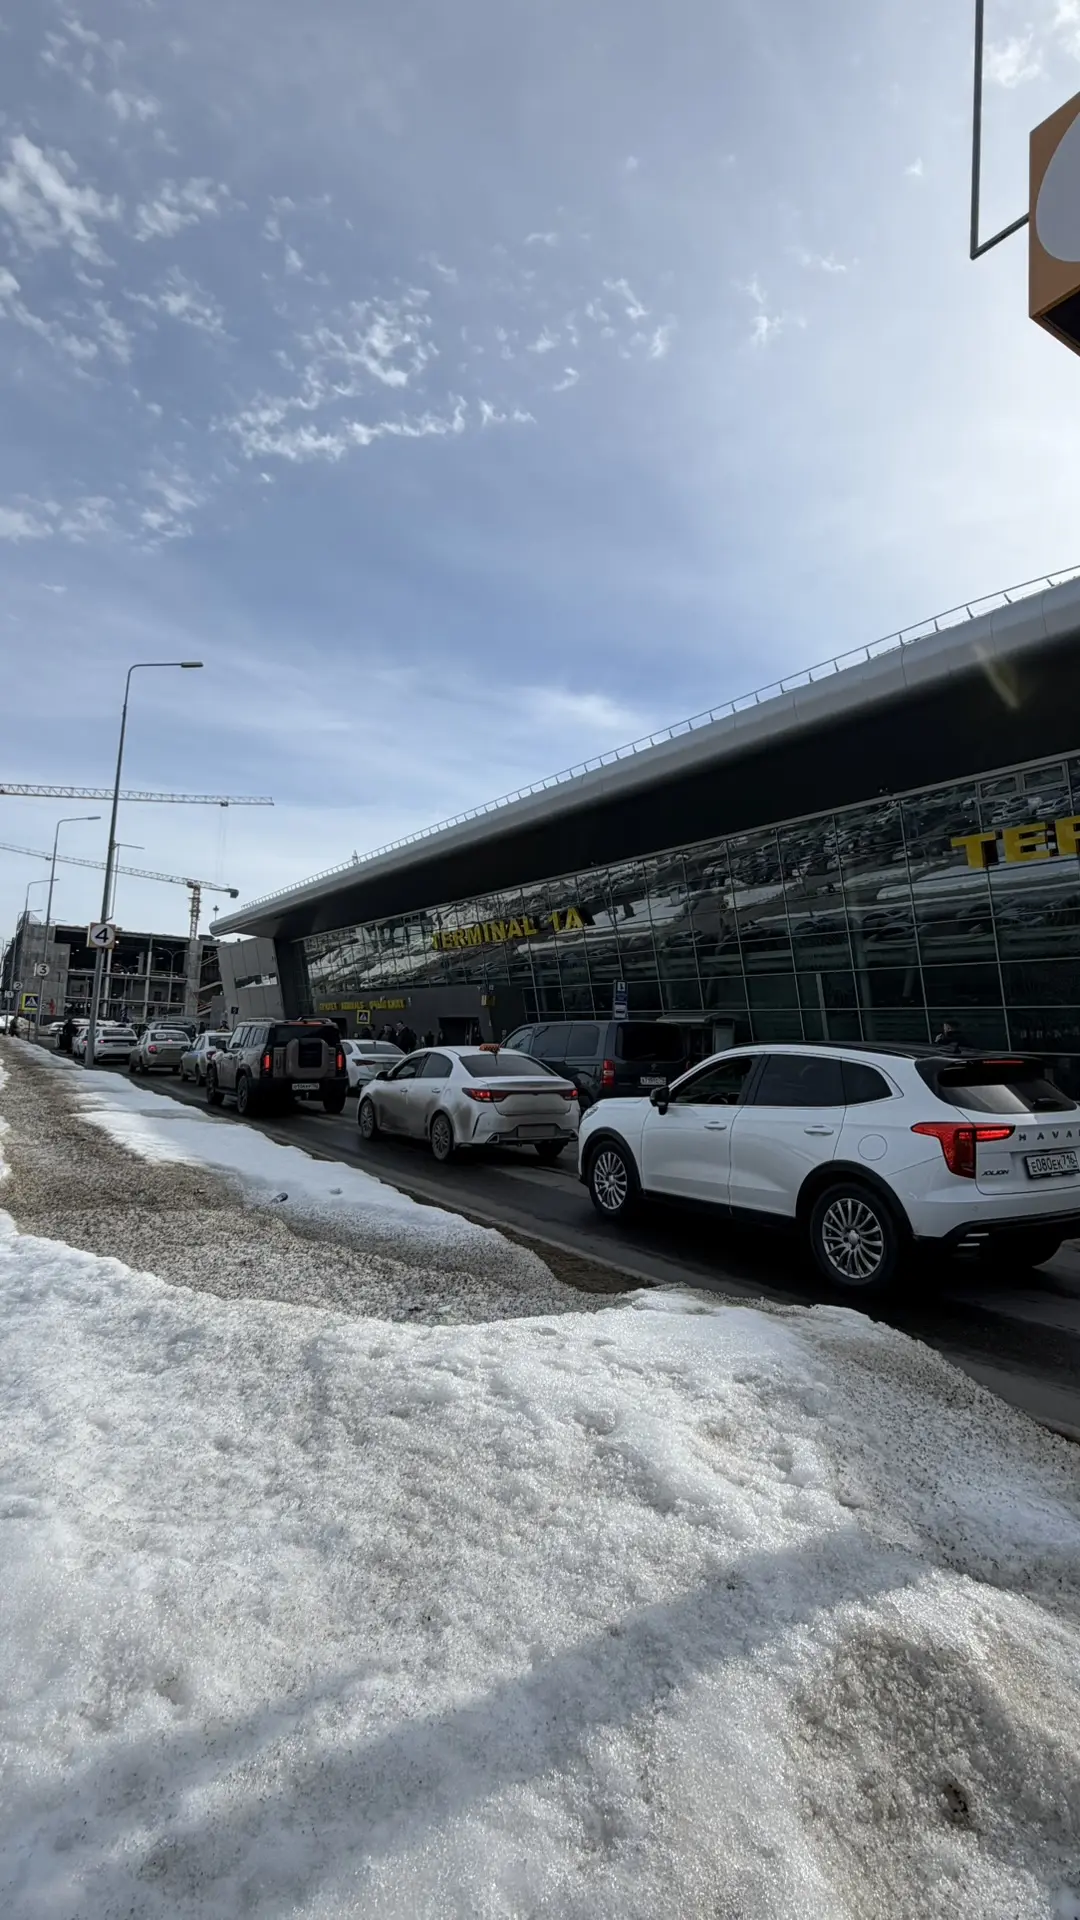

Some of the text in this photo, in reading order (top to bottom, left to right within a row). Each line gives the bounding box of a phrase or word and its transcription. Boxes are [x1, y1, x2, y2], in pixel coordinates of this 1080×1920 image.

[95, 927, 109, 943] 4
[431, 906, 585, 951] TERMINAL 1A
[1018, 1129, 1080, 1141] HAVA
[981, 1169, 1010, 1177] JOLION
